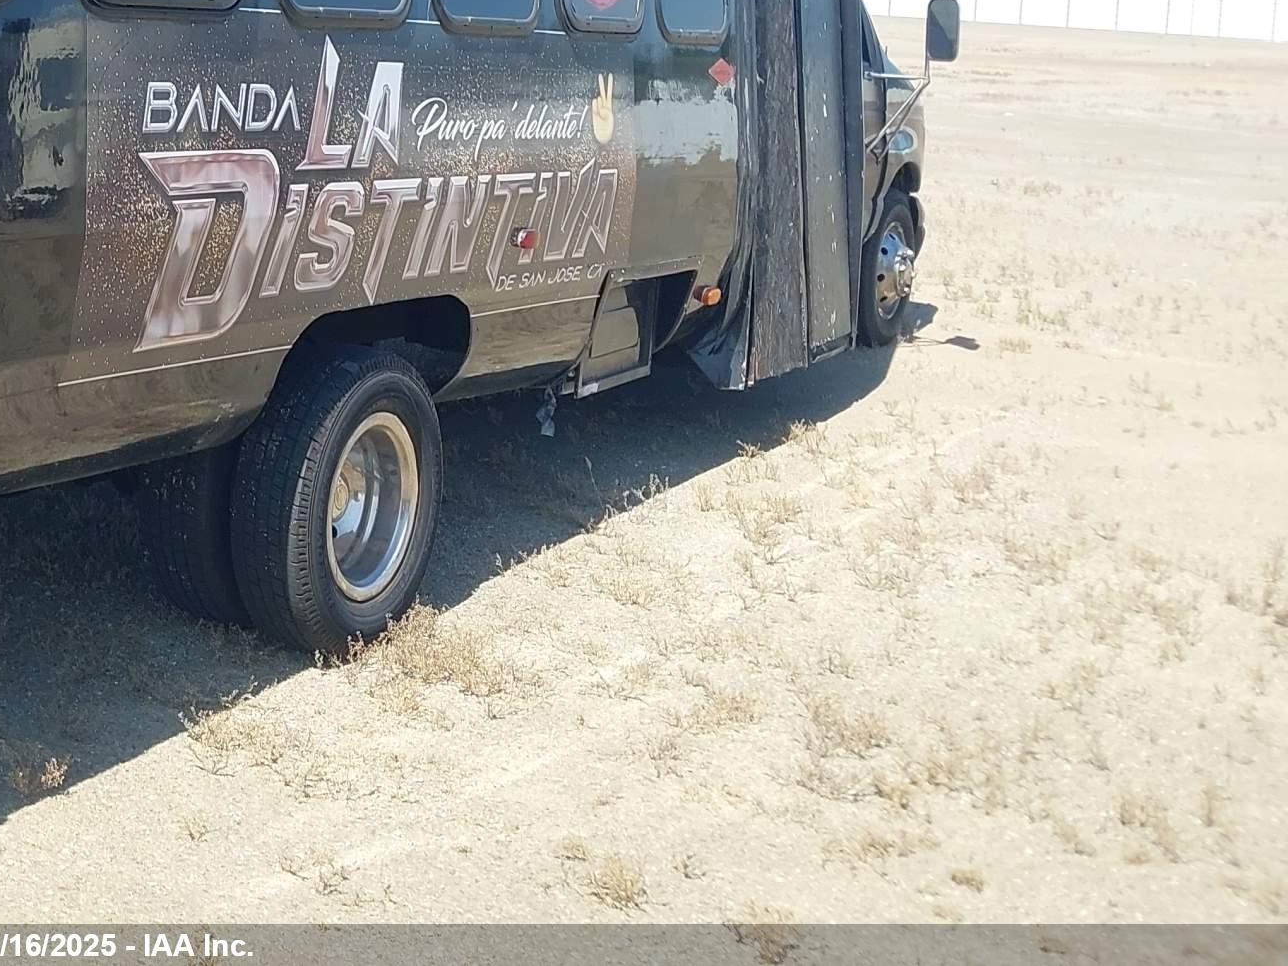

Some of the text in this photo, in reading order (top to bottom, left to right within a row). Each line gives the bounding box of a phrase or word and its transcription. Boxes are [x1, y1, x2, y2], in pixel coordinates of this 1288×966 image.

[142, 34, 405, 171] BANDA LA
[411, 97, 478, 152] Puro
[496, 274, 518, 292] DE
[519, 271, 546, 289] SAN
